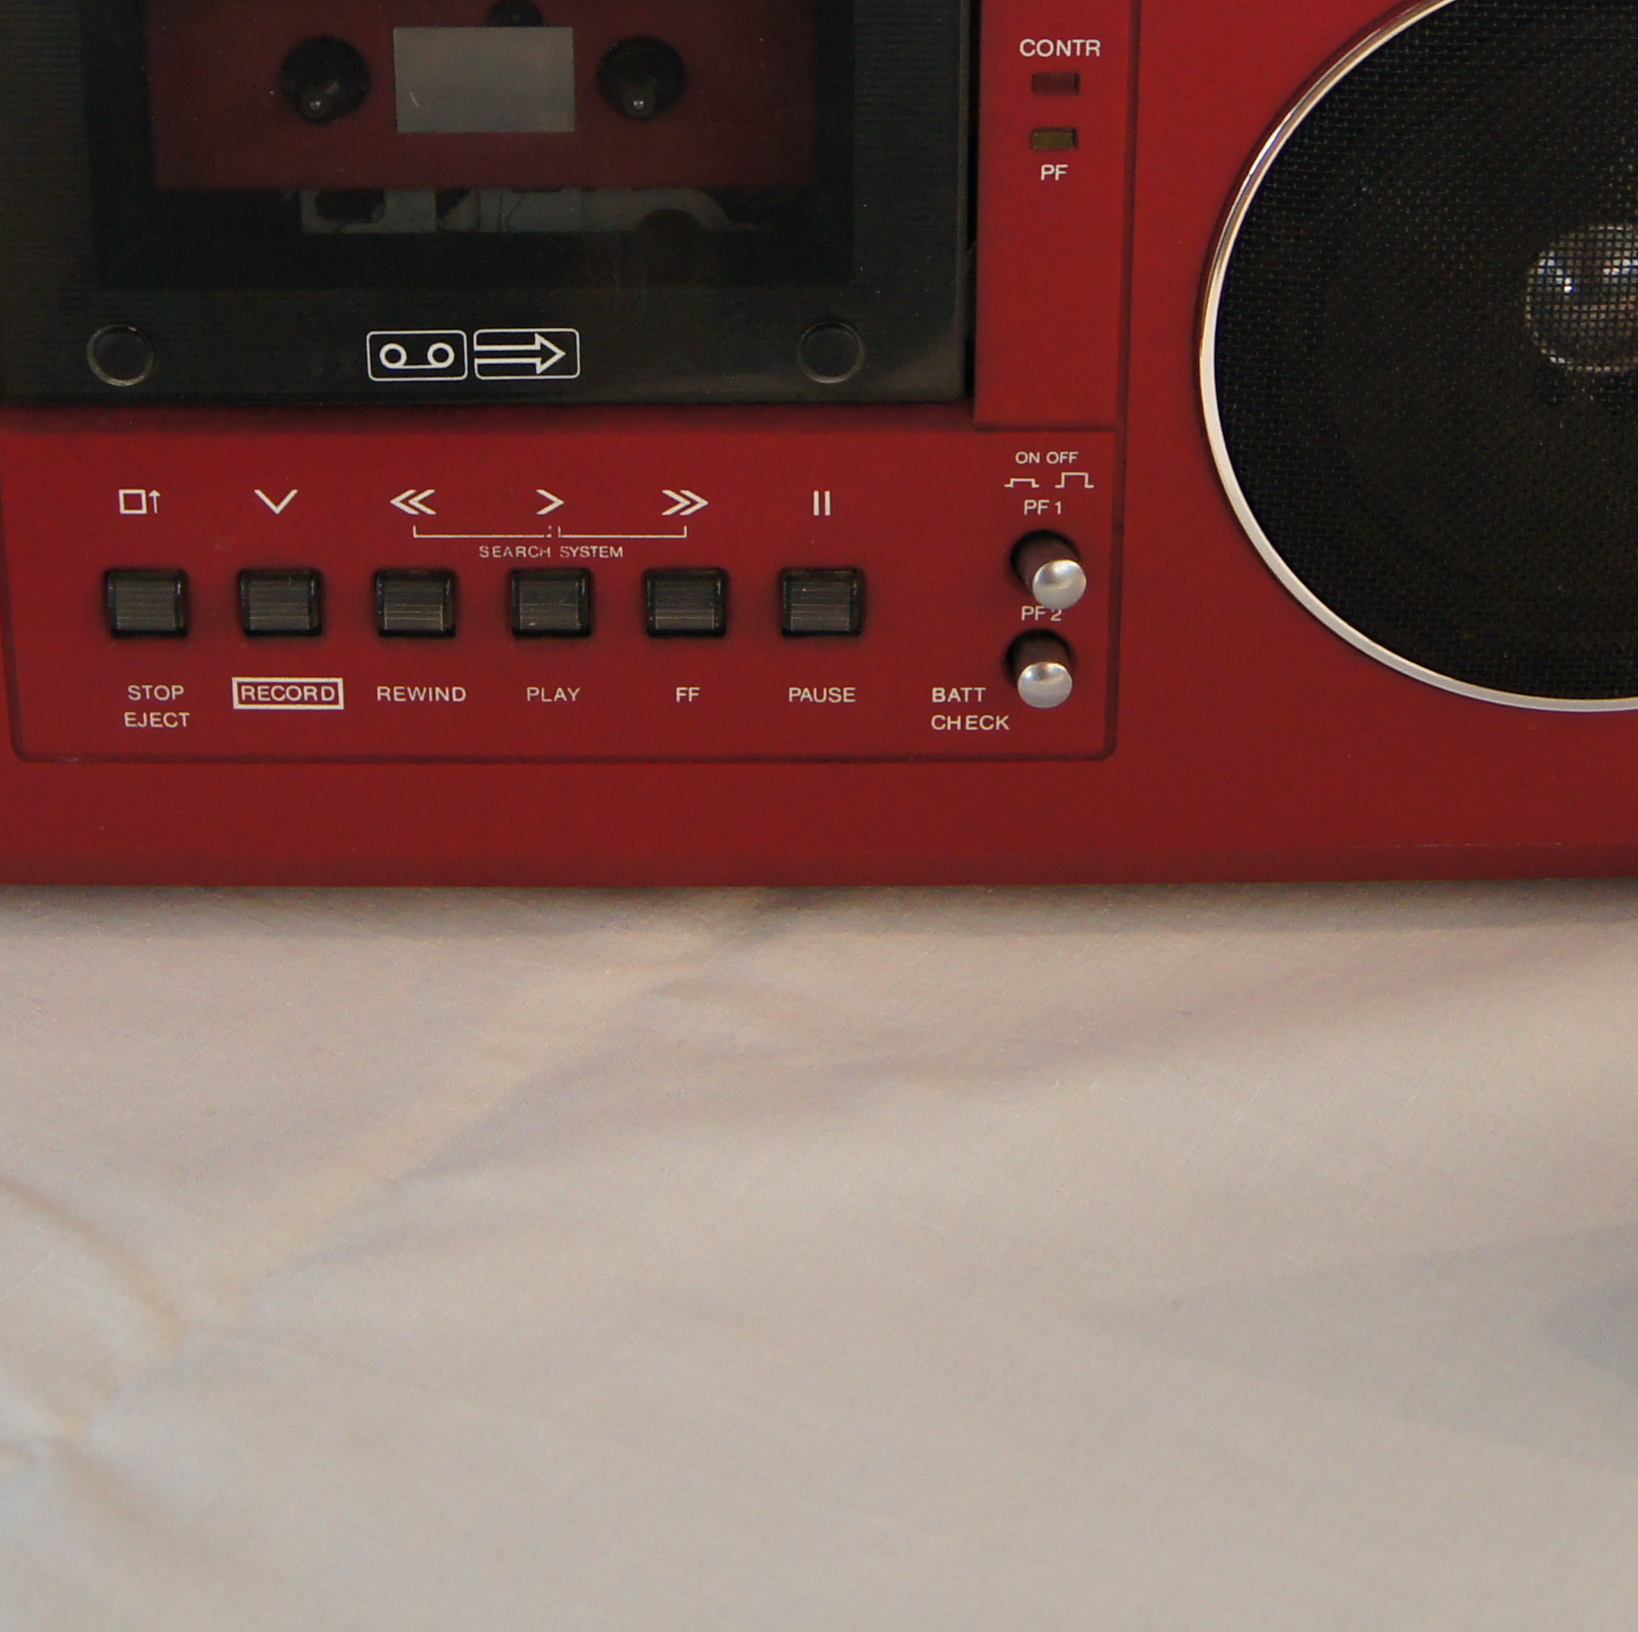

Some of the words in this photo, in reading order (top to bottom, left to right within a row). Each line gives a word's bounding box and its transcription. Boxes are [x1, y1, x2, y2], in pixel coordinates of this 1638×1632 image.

[1019, 38, 1101, 58] CONTR
[1040, 163, 1069, 181] PF
[1015, 451, 1041, 465] ON
[1045, 451, 1079, 465] OFF
[1023, 499, 1050, 516] PF
[560, 545, 624, 559] SYSTEM
[1019, 605, 1047, 622] PF
[127, 684, 185, 702] STOP
[239, 683, 339, 704] RECORD
[376, 685, 467, 702] REWIND
[526, 686, 581, 703] PLAY
[675, 686, 701, 703] FF
[788, 686, 856, 704] PAUSE
[931, 687, 987, 703] BATT
[123, 711, 191, 728] EJECT
[930, 714, 1010, 731] CHECK
